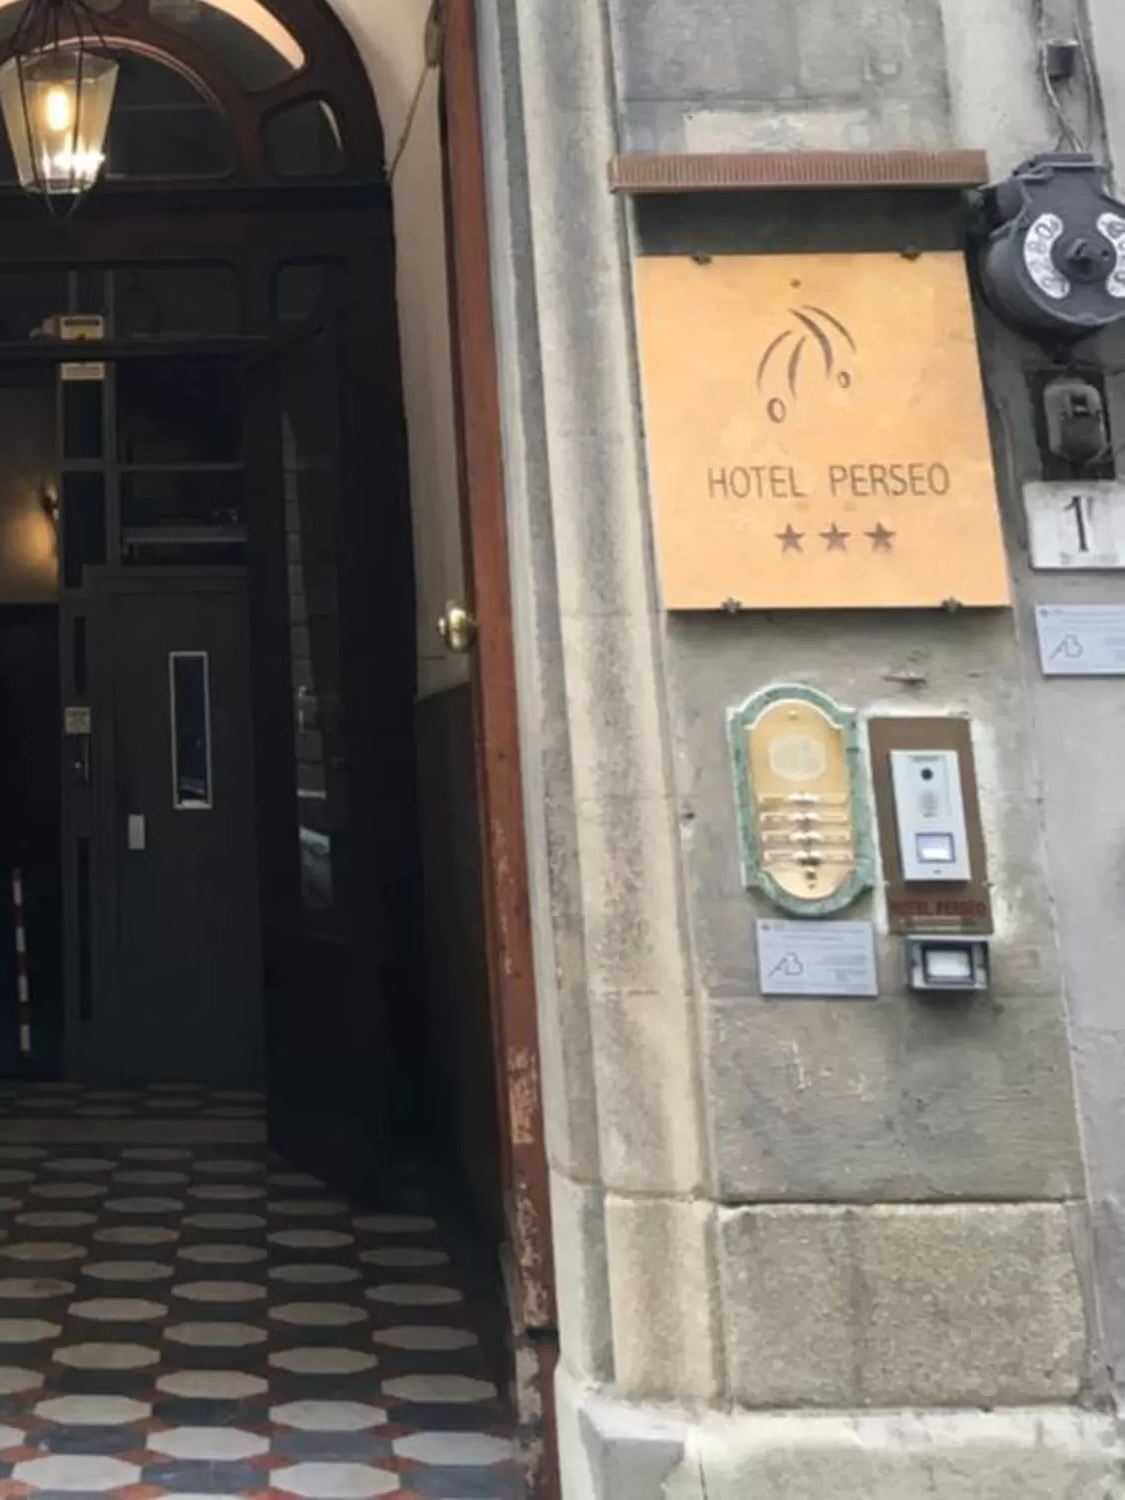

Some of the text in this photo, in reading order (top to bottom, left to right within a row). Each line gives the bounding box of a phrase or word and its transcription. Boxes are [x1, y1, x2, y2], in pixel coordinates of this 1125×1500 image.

[706, 462, 951, 499] HOTEL PERSEO
[1063, 495, 1089, 552] 1
